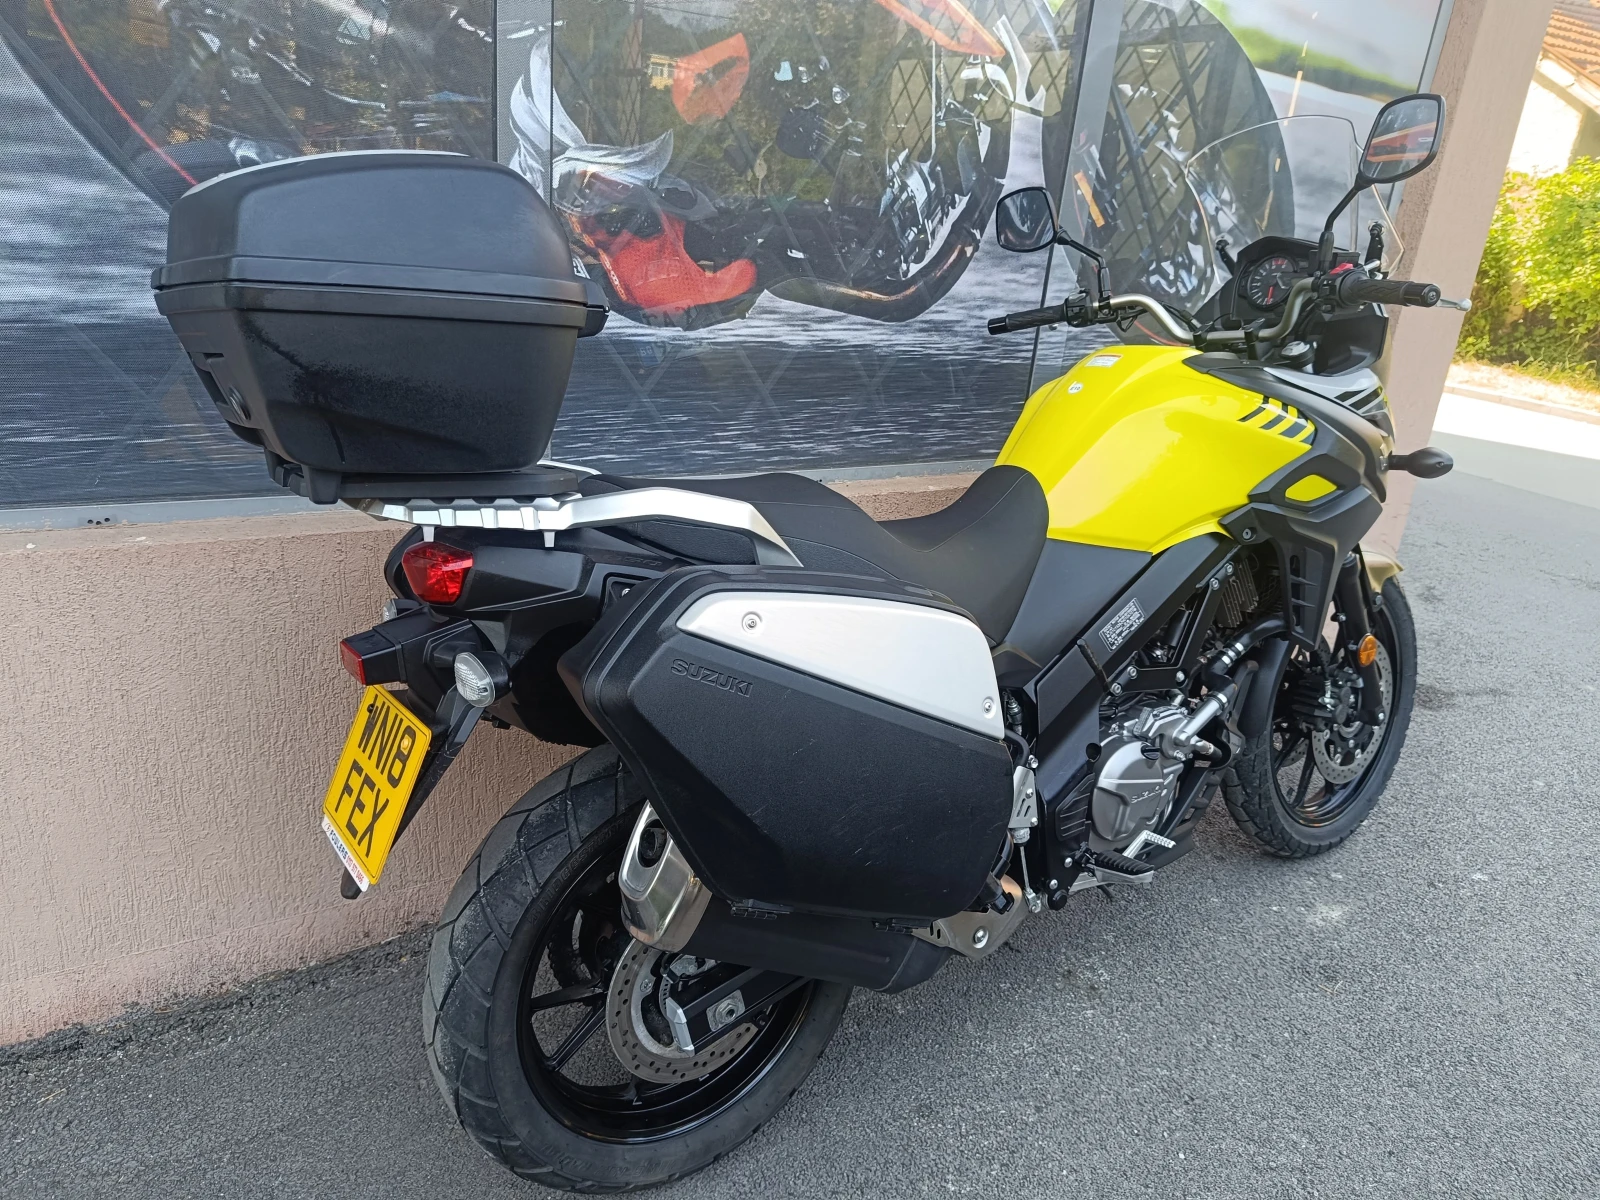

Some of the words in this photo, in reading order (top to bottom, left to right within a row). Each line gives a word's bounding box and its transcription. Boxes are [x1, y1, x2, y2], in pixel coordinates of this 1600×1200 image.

[671, 658, 753, 697] SUZUKI
[358, 693, 416, 789] WN18
[335, 758, 389, 858] FEX
